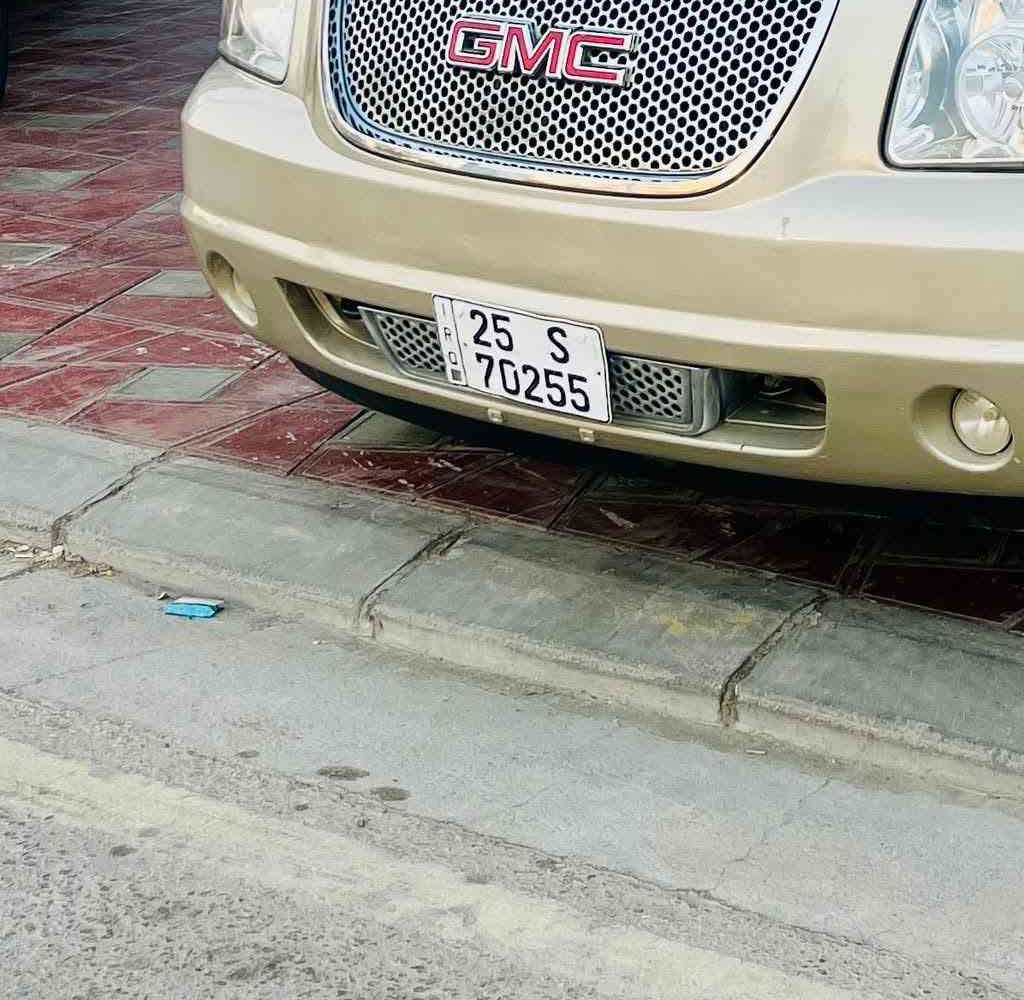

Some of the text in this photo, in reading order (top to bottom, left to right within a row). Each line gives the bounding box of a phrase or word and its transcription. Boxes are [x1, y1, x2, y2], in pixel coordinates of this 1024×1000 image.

[447, 14, 635, 88] GMC
[469, 308, 570, 365] 25 S
[474, 351, 591, 413] 70255
